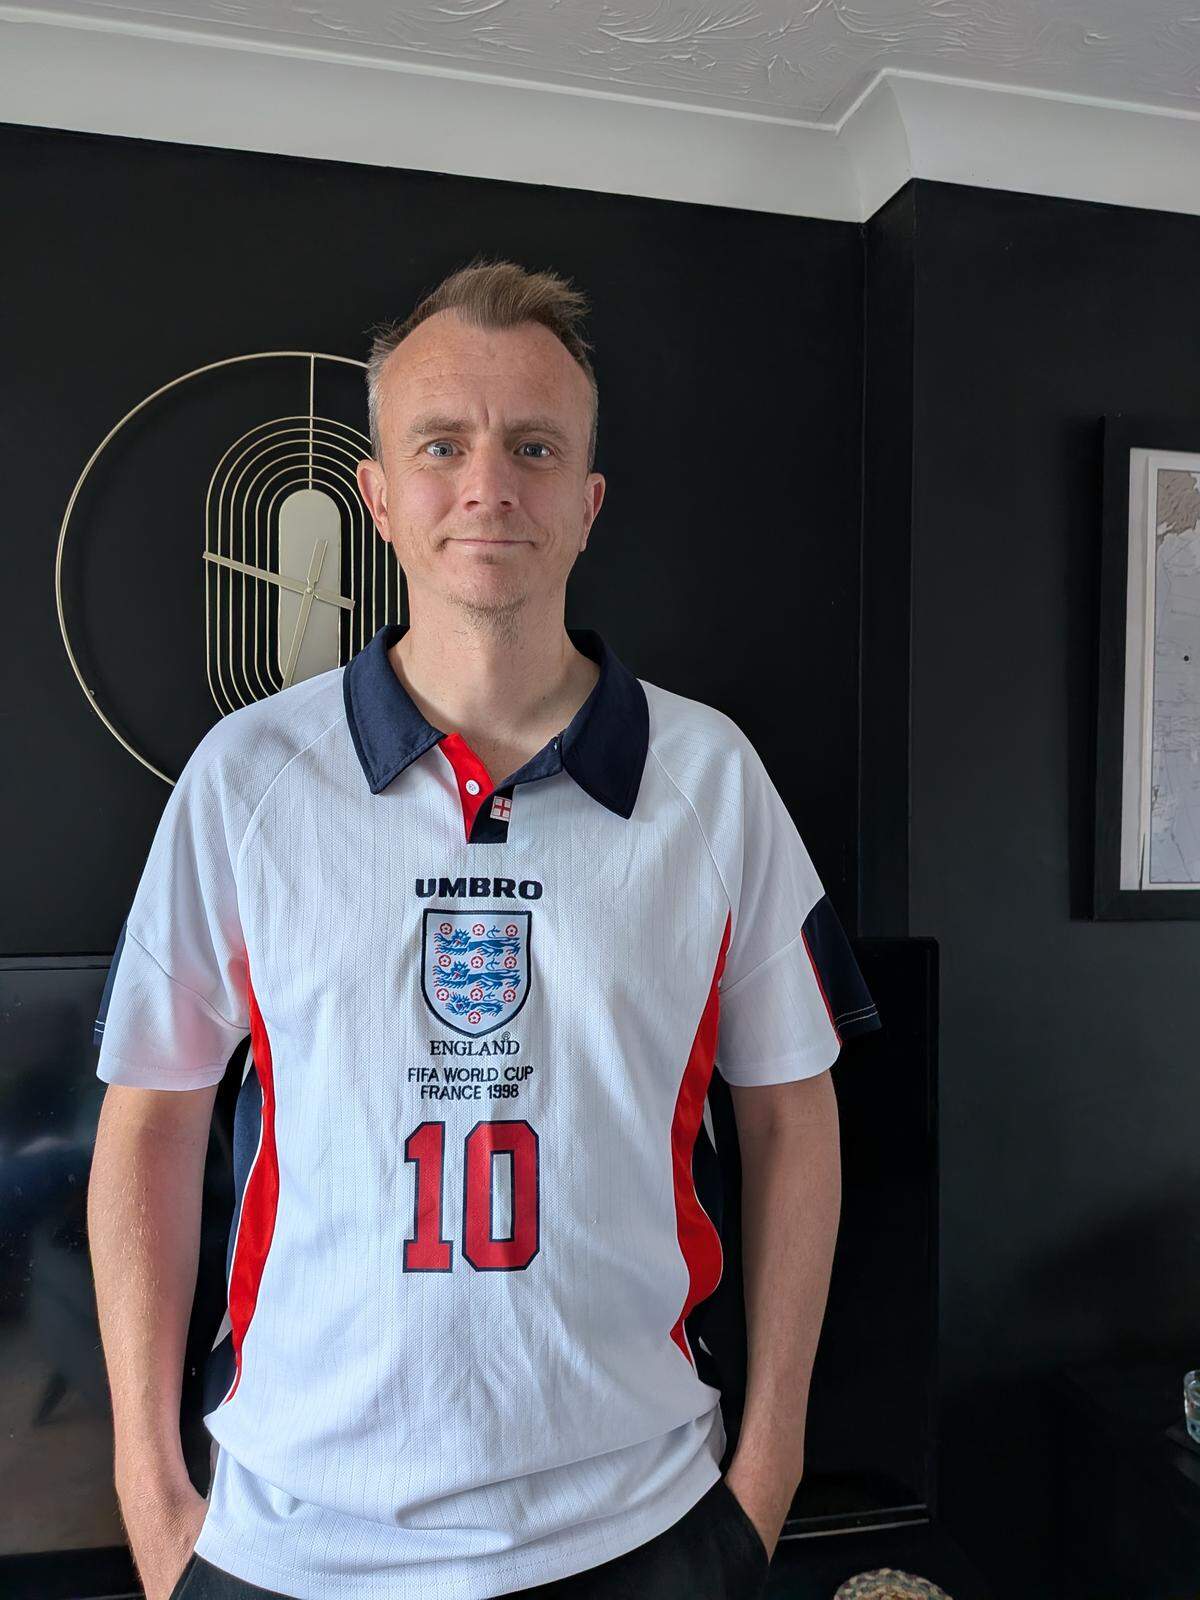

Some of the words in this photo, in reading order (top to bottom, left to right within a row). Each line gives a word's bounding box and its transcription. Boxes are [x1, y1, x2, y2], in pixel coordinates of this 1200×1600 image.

[415, 877, 543, 900] UMBRO
[429, 1040, 520, 1056] ENGLAND
[408, 1067, 439, 1083] FIFA
[444, 1067, 499, 1083] WORLD
[504, 1065, 534, 1082] CUP
[420, 1085, 482, 1100] FRANCE
[487, 1084, 519, 1099] 1998
[403, 1120, 540, 1273] 10
